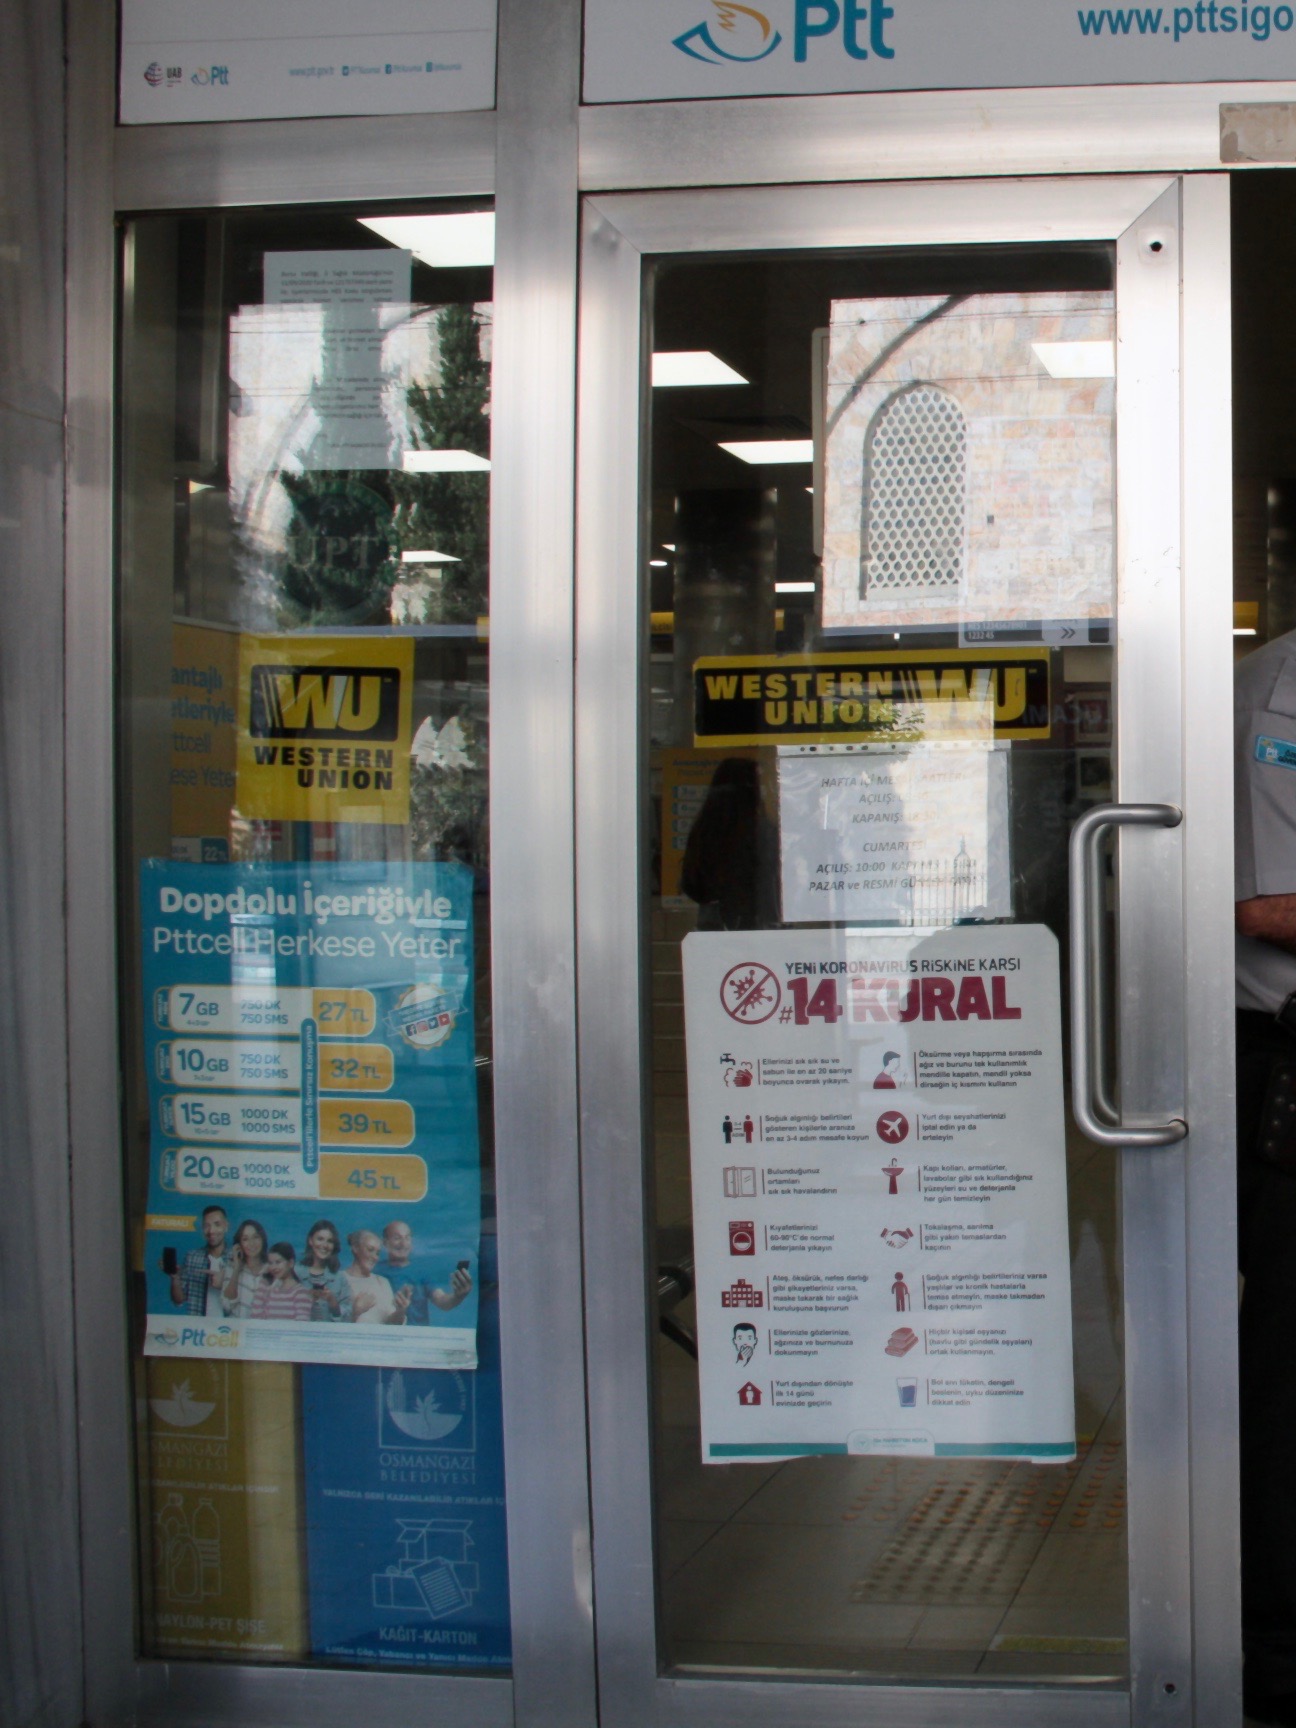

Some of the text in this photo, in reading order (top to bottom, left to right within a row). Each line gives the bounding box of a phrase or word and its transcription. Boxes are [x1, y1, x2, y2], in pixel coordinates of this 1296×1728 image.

[793, 0, 896, 62] Ptt
[166, 67, 182, 79] UAB
[211, 66, 229, 85] Ptt
[704, 670, 894, 700] WESTERN
[902, 668, 1028, 722] WU
[260, 674, 381, 732] WU
[764, 697, 895, 725] UNION
[253, 746, 394, 768] WESTERN
[297, 769, 393, 790] UNION
[821, 777, 857, 788] HAFTA
[816, 863, 853, 875] AÇILIŞ:
[855, 861, 885, 872] 10:00
[809, 880, 845, 892] PAZAR
[848, 881, 860, 890] ve
[159, 880, 452, 925] Dopdolu İçeriğiyle
[153, 927, 462, 959] Pttcell Herkese Yeter
[178, 992, 195, 1015] 7
[196, 1002, 219, 1016] GB
[852, 976, 1022, 1024] KURAL
[240, 1013, 289, 1024] 750 SMS
[318, 1002, 369, 1022] 27 TL
[305, 1025, 316, 1069] Konuşma
[954, 1051, 971, 1059] veya
[176, 1048, 230, 1072] 10 GB
[240, 1053, 281, 1065] 750 DK
[330, 1058, 381, 1080] 32 TL
[240, 1067, 289, 1079] 750 SMS
[1009, 1070, 1031, 1078] yoksa
[180, 1102, 231, 1126] 15 GB
[240, 1108, 288, 1120] 1000 DK
[338, 1113, 392, 1134] 39 TL
[241, 1122, 296, 1134] 1000 SMS
[183, 1155, 240, 1180] 20 GB
[244, 1163, 290, 1175] 1000 DK
[244, 1177, 296, 1189] 1000 SMS
[347, 1169, 400, 1190] 45 TL
[181, 1327, 239, 1348] Pttcell
[379, 1626, 477, 1645] KAĞIT-KARTON
